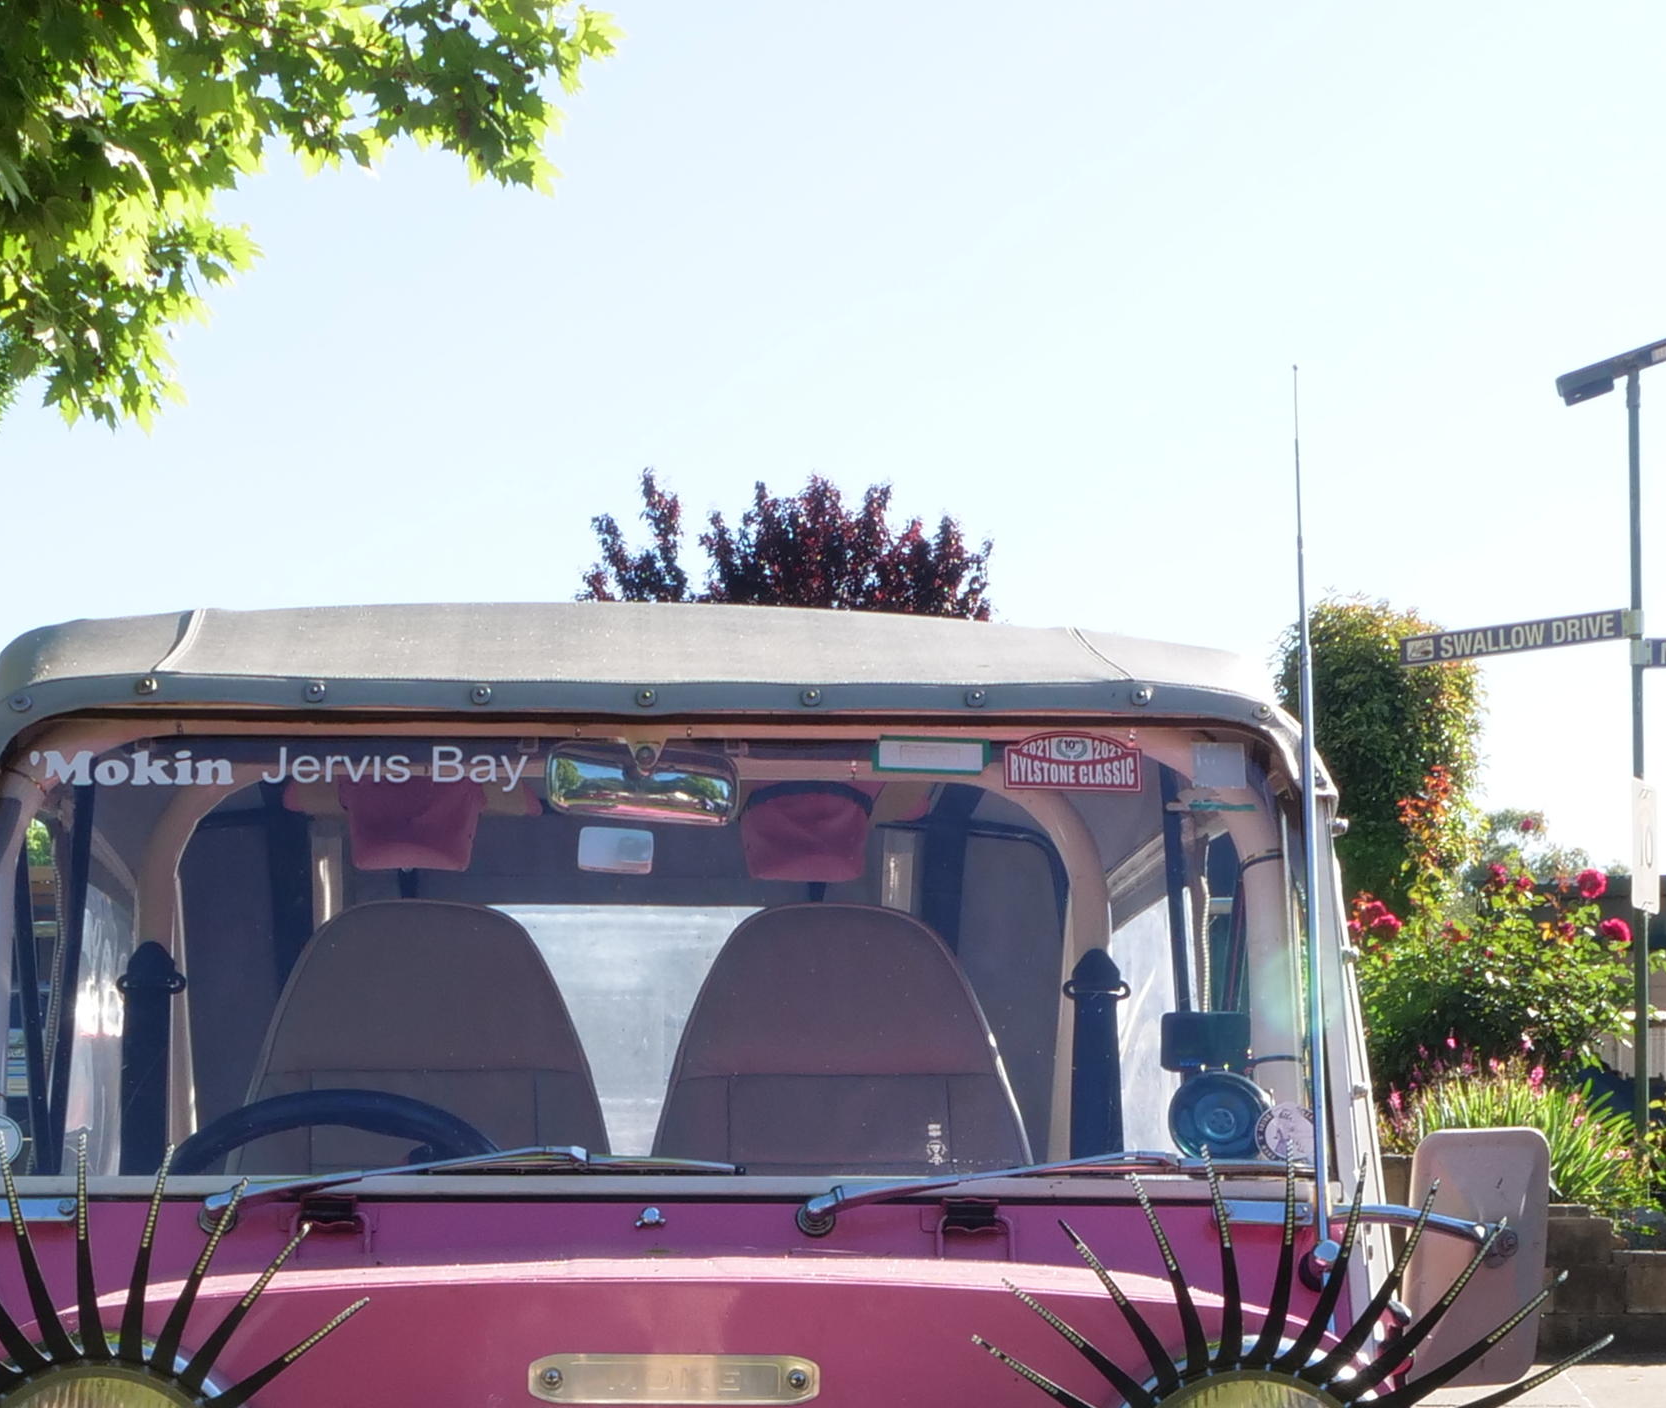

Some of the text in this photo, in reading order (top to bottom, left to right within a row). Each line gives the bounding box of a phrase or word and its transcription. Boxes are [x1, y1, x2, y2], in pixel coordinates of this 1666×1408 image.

[1440, 623, 1545, 659] SWALLOW
[1551, 614, 1615, 644] DRIVE
[262, 746, 411, 784] Jervis
[431, 746, 529, 792] Bay
[1010, 752, 1135, 785] RYLSTONE CLASSIC
